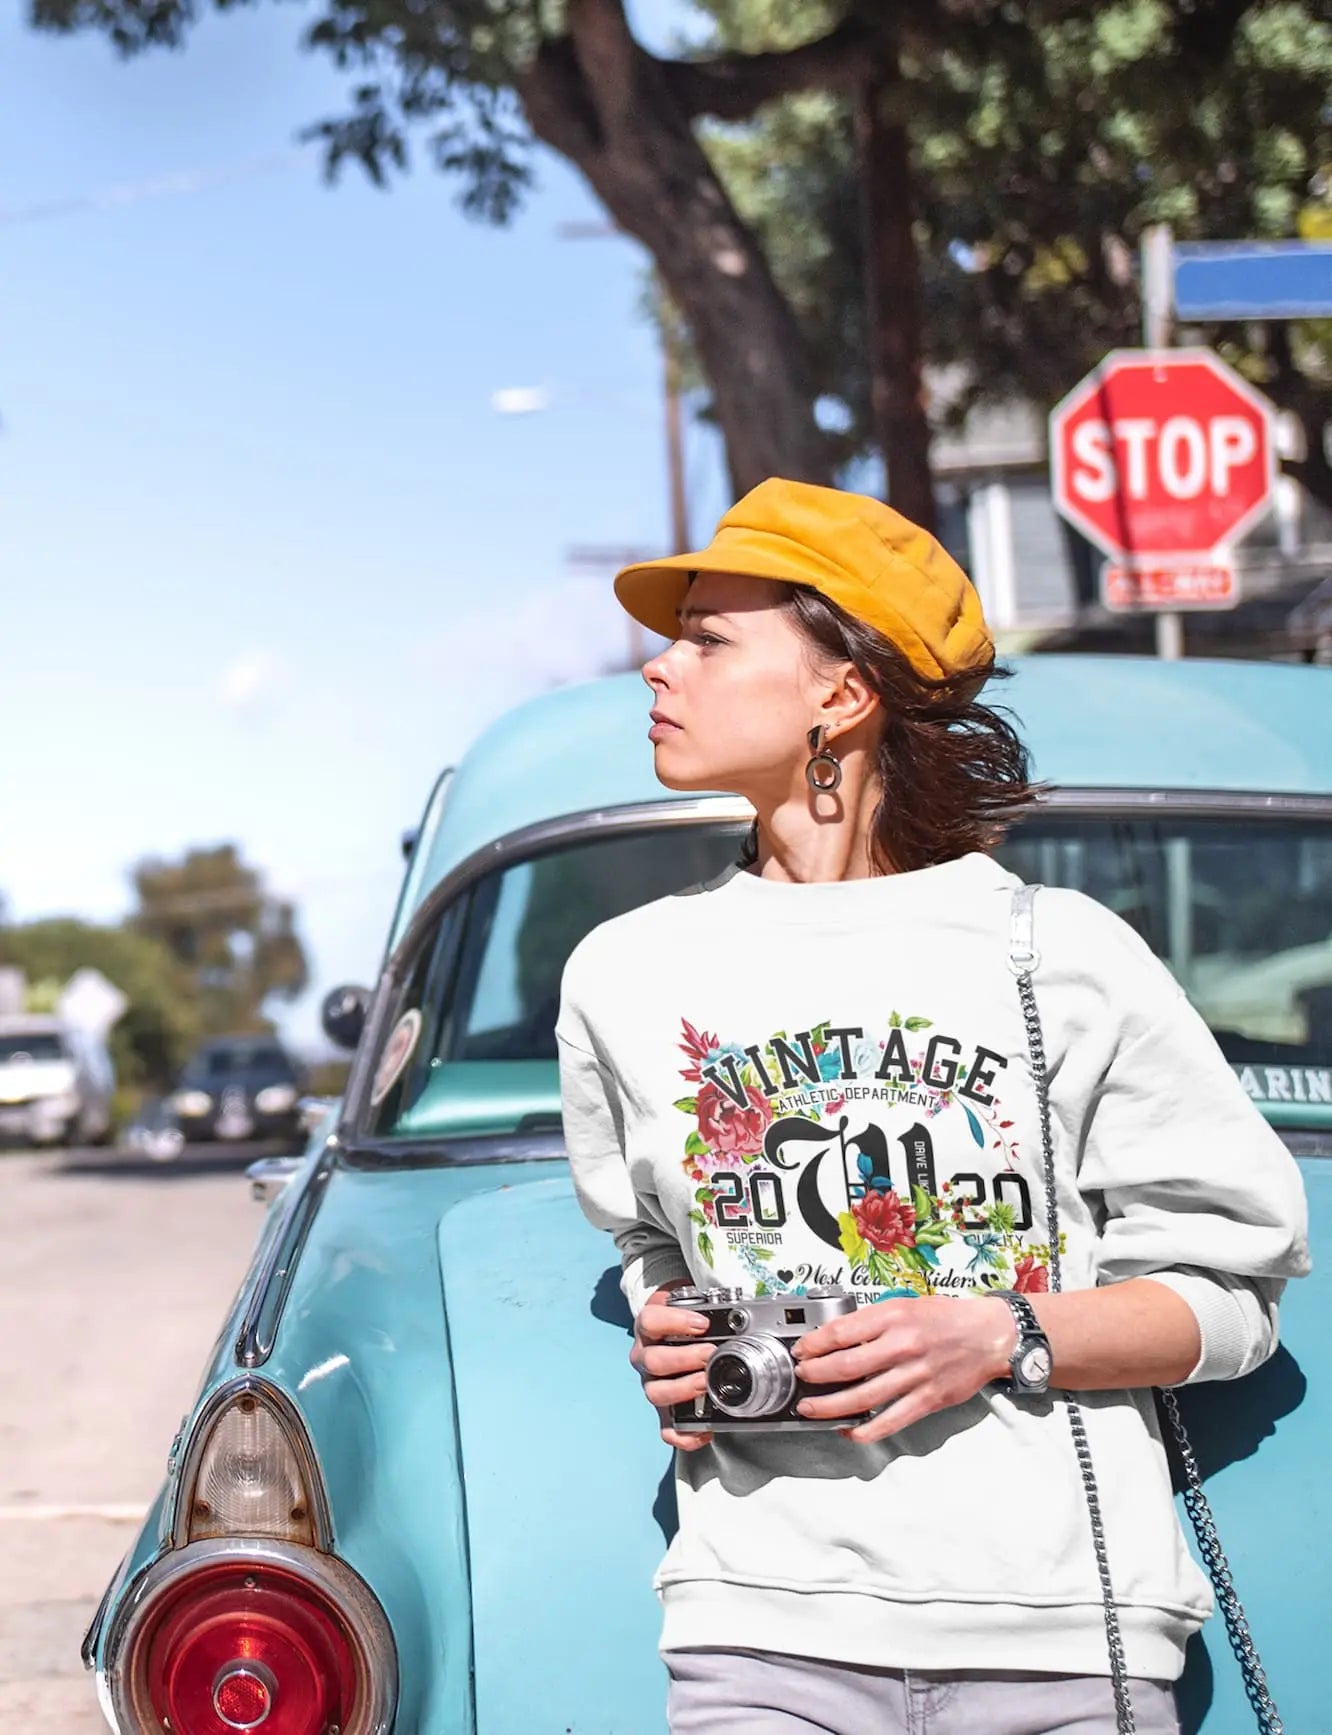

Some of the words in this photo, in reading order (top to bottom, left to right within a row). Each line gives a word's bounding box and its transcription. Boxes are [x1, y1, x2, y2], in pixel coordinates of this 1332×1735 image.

[1072, 416, 1257, 502] STOP
[701, 1026, 1008, 1110] VINTAGE
[778, 1088, 839, 1112] ATHLETIC
[845, 1087, 936, 1108] DEPARTMENT
[914, 1141, 928, 1169] DRIVE
[918, 1173, 930, 1196] LIK
[711, 1172, 787, 1228] 20
[949, 1172, 1033, 1231] 20
[727, 1232, 783, 1245] SUPERIOR
[795, 1263, 843, 1286] West
